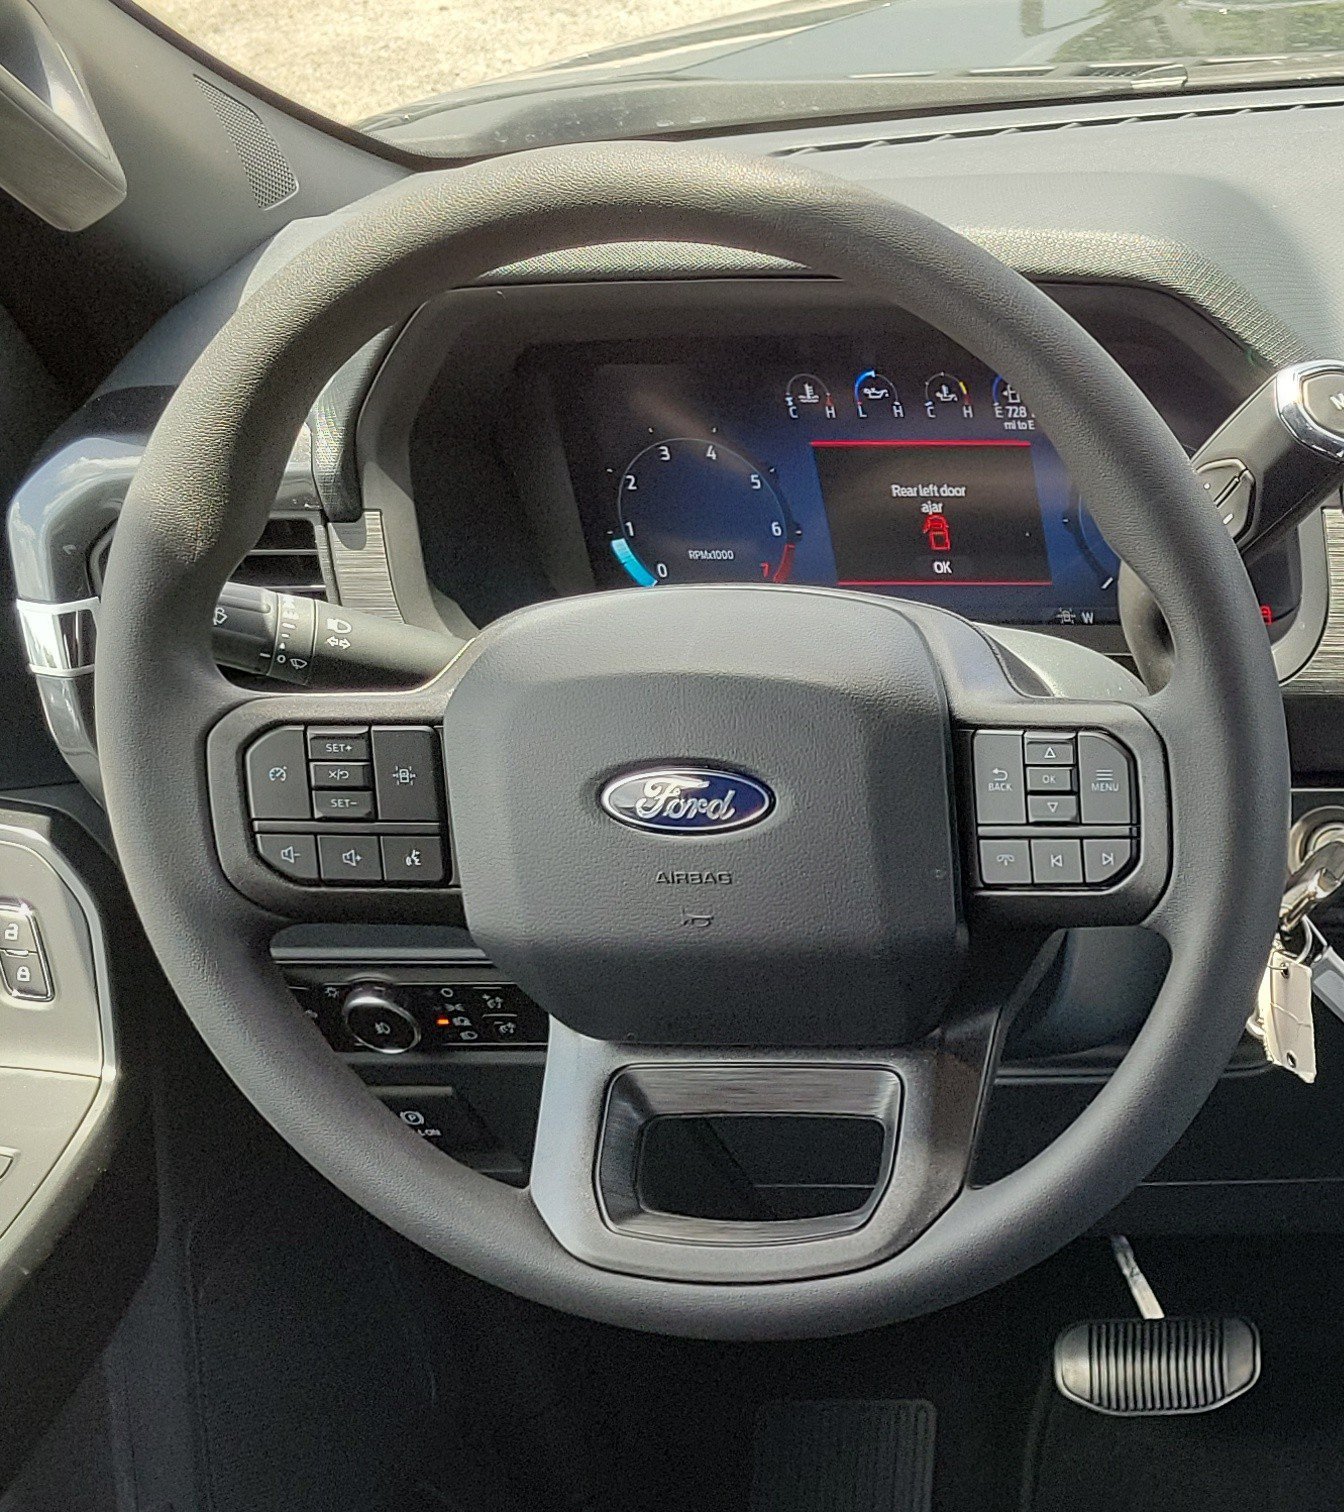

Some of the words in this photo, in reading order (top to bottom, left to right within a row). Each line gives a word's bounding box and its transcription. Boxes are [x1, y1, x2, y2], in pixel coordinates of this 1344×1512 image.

[789, 406, 798, 418] C
[825, 406, 836, 418] H
[858, 405, 867, 418] L
[893, 406, 904, 418] H
[926, 406, 936, 418] C
[963, 406, 973, 418] H
[995, 406, 1004, 418] E
[1005, 405, 1027, 418] 728
[1004, 420, 1016, 430] mi
[1017, 420, 1027, 430] to
[1027, 420, 1036, 430] E
[659, 446, 671, 461] 3
[706, 445, 717, 460] 4
[626, 475, 638, 490] 2
[750, 474, 761, 489] 5
[891, 484, 918, 497] Rear
[918, 484, 939, 497] left
[940, 483, 967, 497] door
[921, 500, 943, 515] ajar
[625, 521, 634, 536] 1
[771, 522, 782, 536] 6
[689, 550, 734, 560] RPMx1000
[657, 563, 668, 578] 0
[933, 561, 952, 574] OK
[326, 743, 353, 753] SET+
[1043, 774, 1056, 784] OK
[988, 782, 1012, 792] BACK
[1091, 782, 1119, 792] MENU
[634, 774, 736, 820] Ford
[656, 871, 732, 885] AIRBAG
